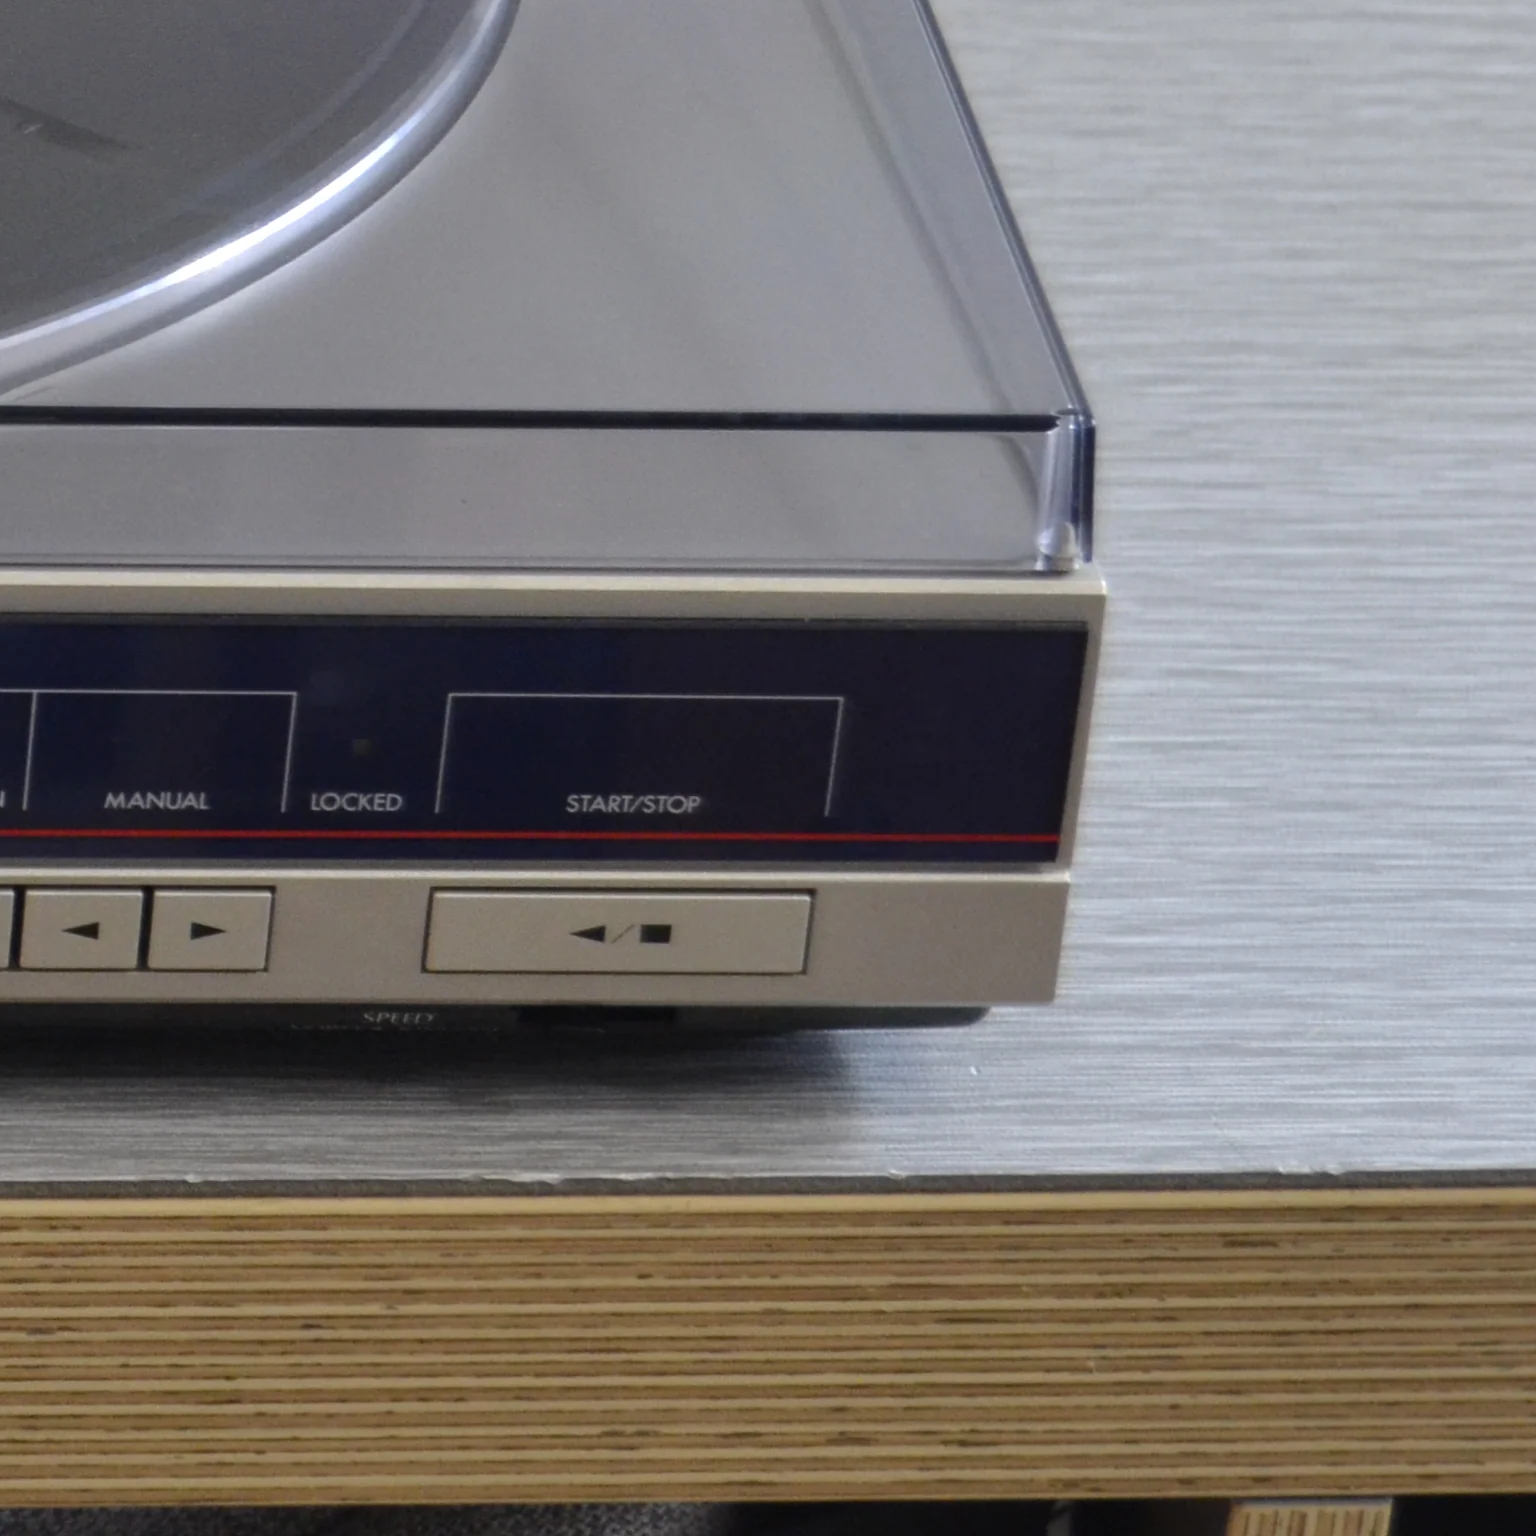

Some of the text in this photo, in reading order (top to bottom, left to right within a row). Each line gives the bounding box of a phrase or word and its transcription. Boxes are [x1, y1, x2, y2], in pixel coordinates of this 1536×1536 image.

[103, 791, 210, 810] MANUAL
[311, 792, 403, 812] LOCKED
[566, 794, 701, 814] START/STOP
